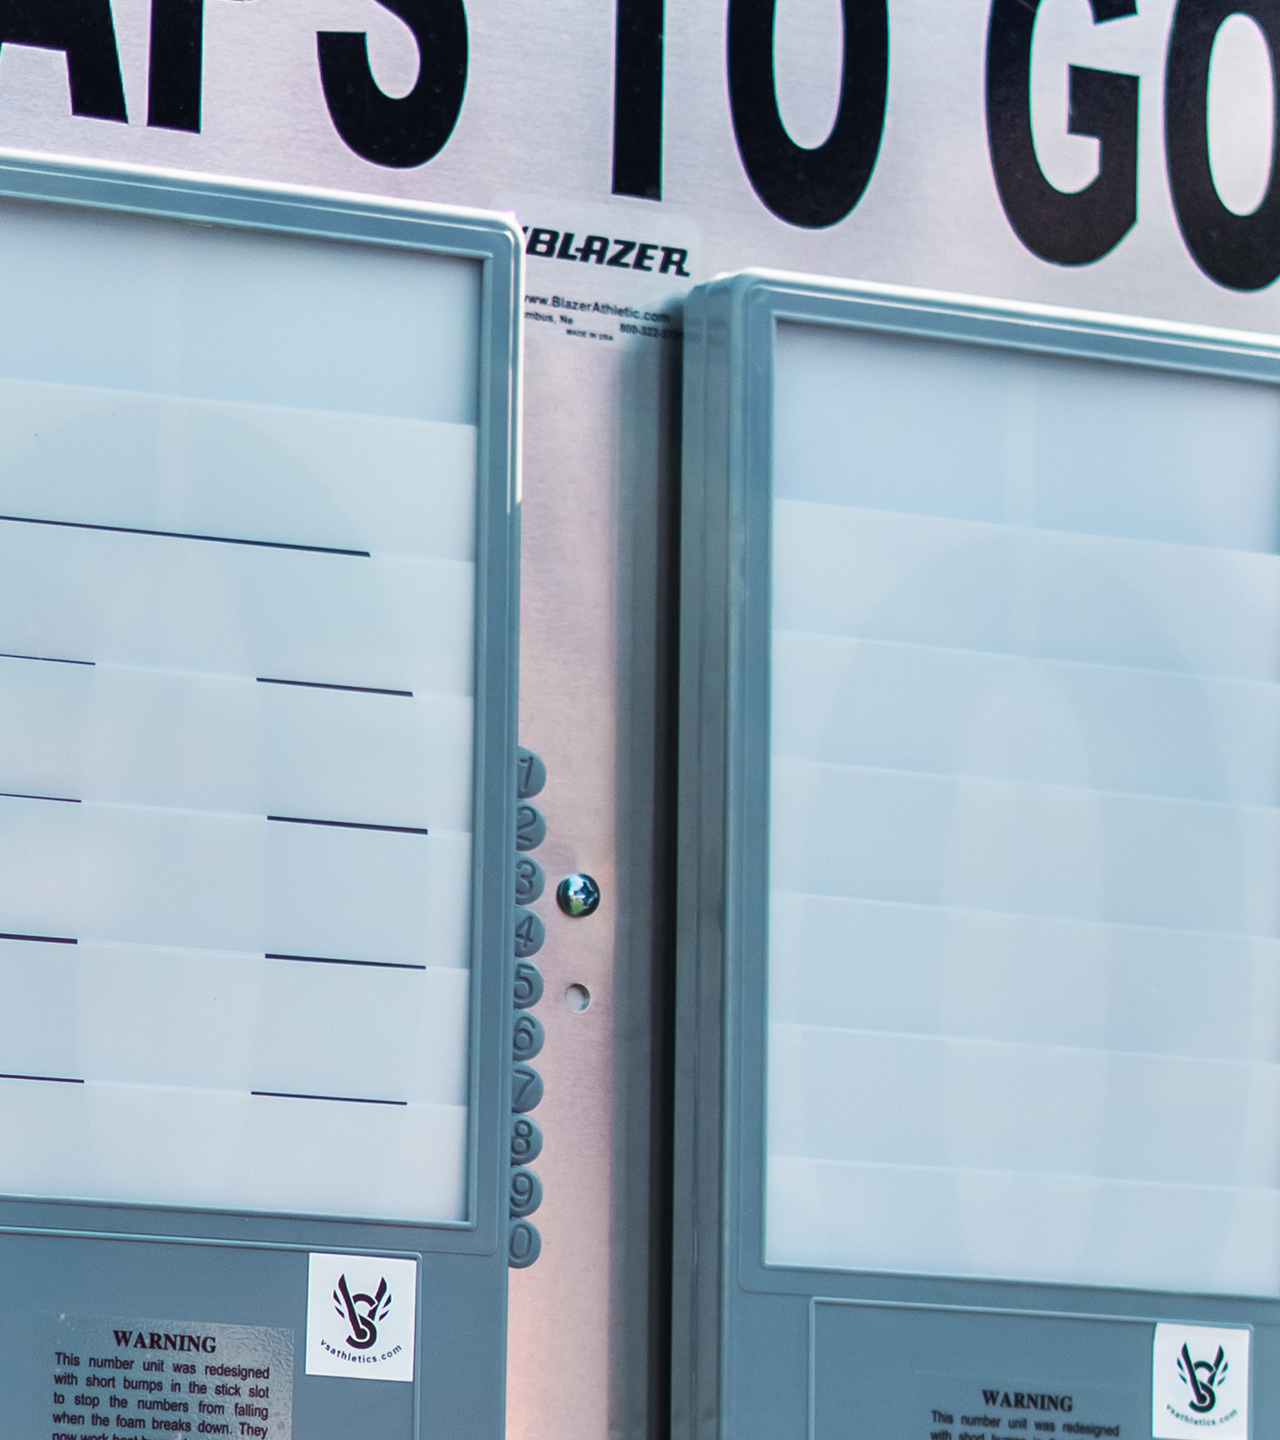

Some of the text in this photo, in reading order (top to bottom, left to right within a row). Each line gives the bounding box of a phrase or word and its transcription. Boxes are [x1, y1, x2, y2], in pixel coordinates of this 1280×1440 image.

[522, 226, 691, 277] BLAZER
[519, 756, 534, 790] 1
[517, 805, 537, 842] 2
[517, 861, 536, 896] 3
[515, 915, 534, 949] 4
[514, 963, 535, 1000] 5
[514, 1016, 536, 1051] 6
[514, 1069, 535, 1105] 7
[511, 1120, 533, 1156] 8
[510, 1172, 533, 1208] 9
[113, 1330, 216, 1353] WARNING
[320, 1339, 403, 1363] vsathletics.com
[55, 1352, 270, 1381] This number unit was redesigned
[54, 1373, 269, 1398] with short bumps in the stick slot
[982, 1389, 1073, 1412] WARNING
[54, 1393, 268, 1420] to stop the numbers from falling
[53, 1412, 268, 1440] when the foam breaks down. They
[932, 1410, 1119, 1438] This number unit was redesigned
